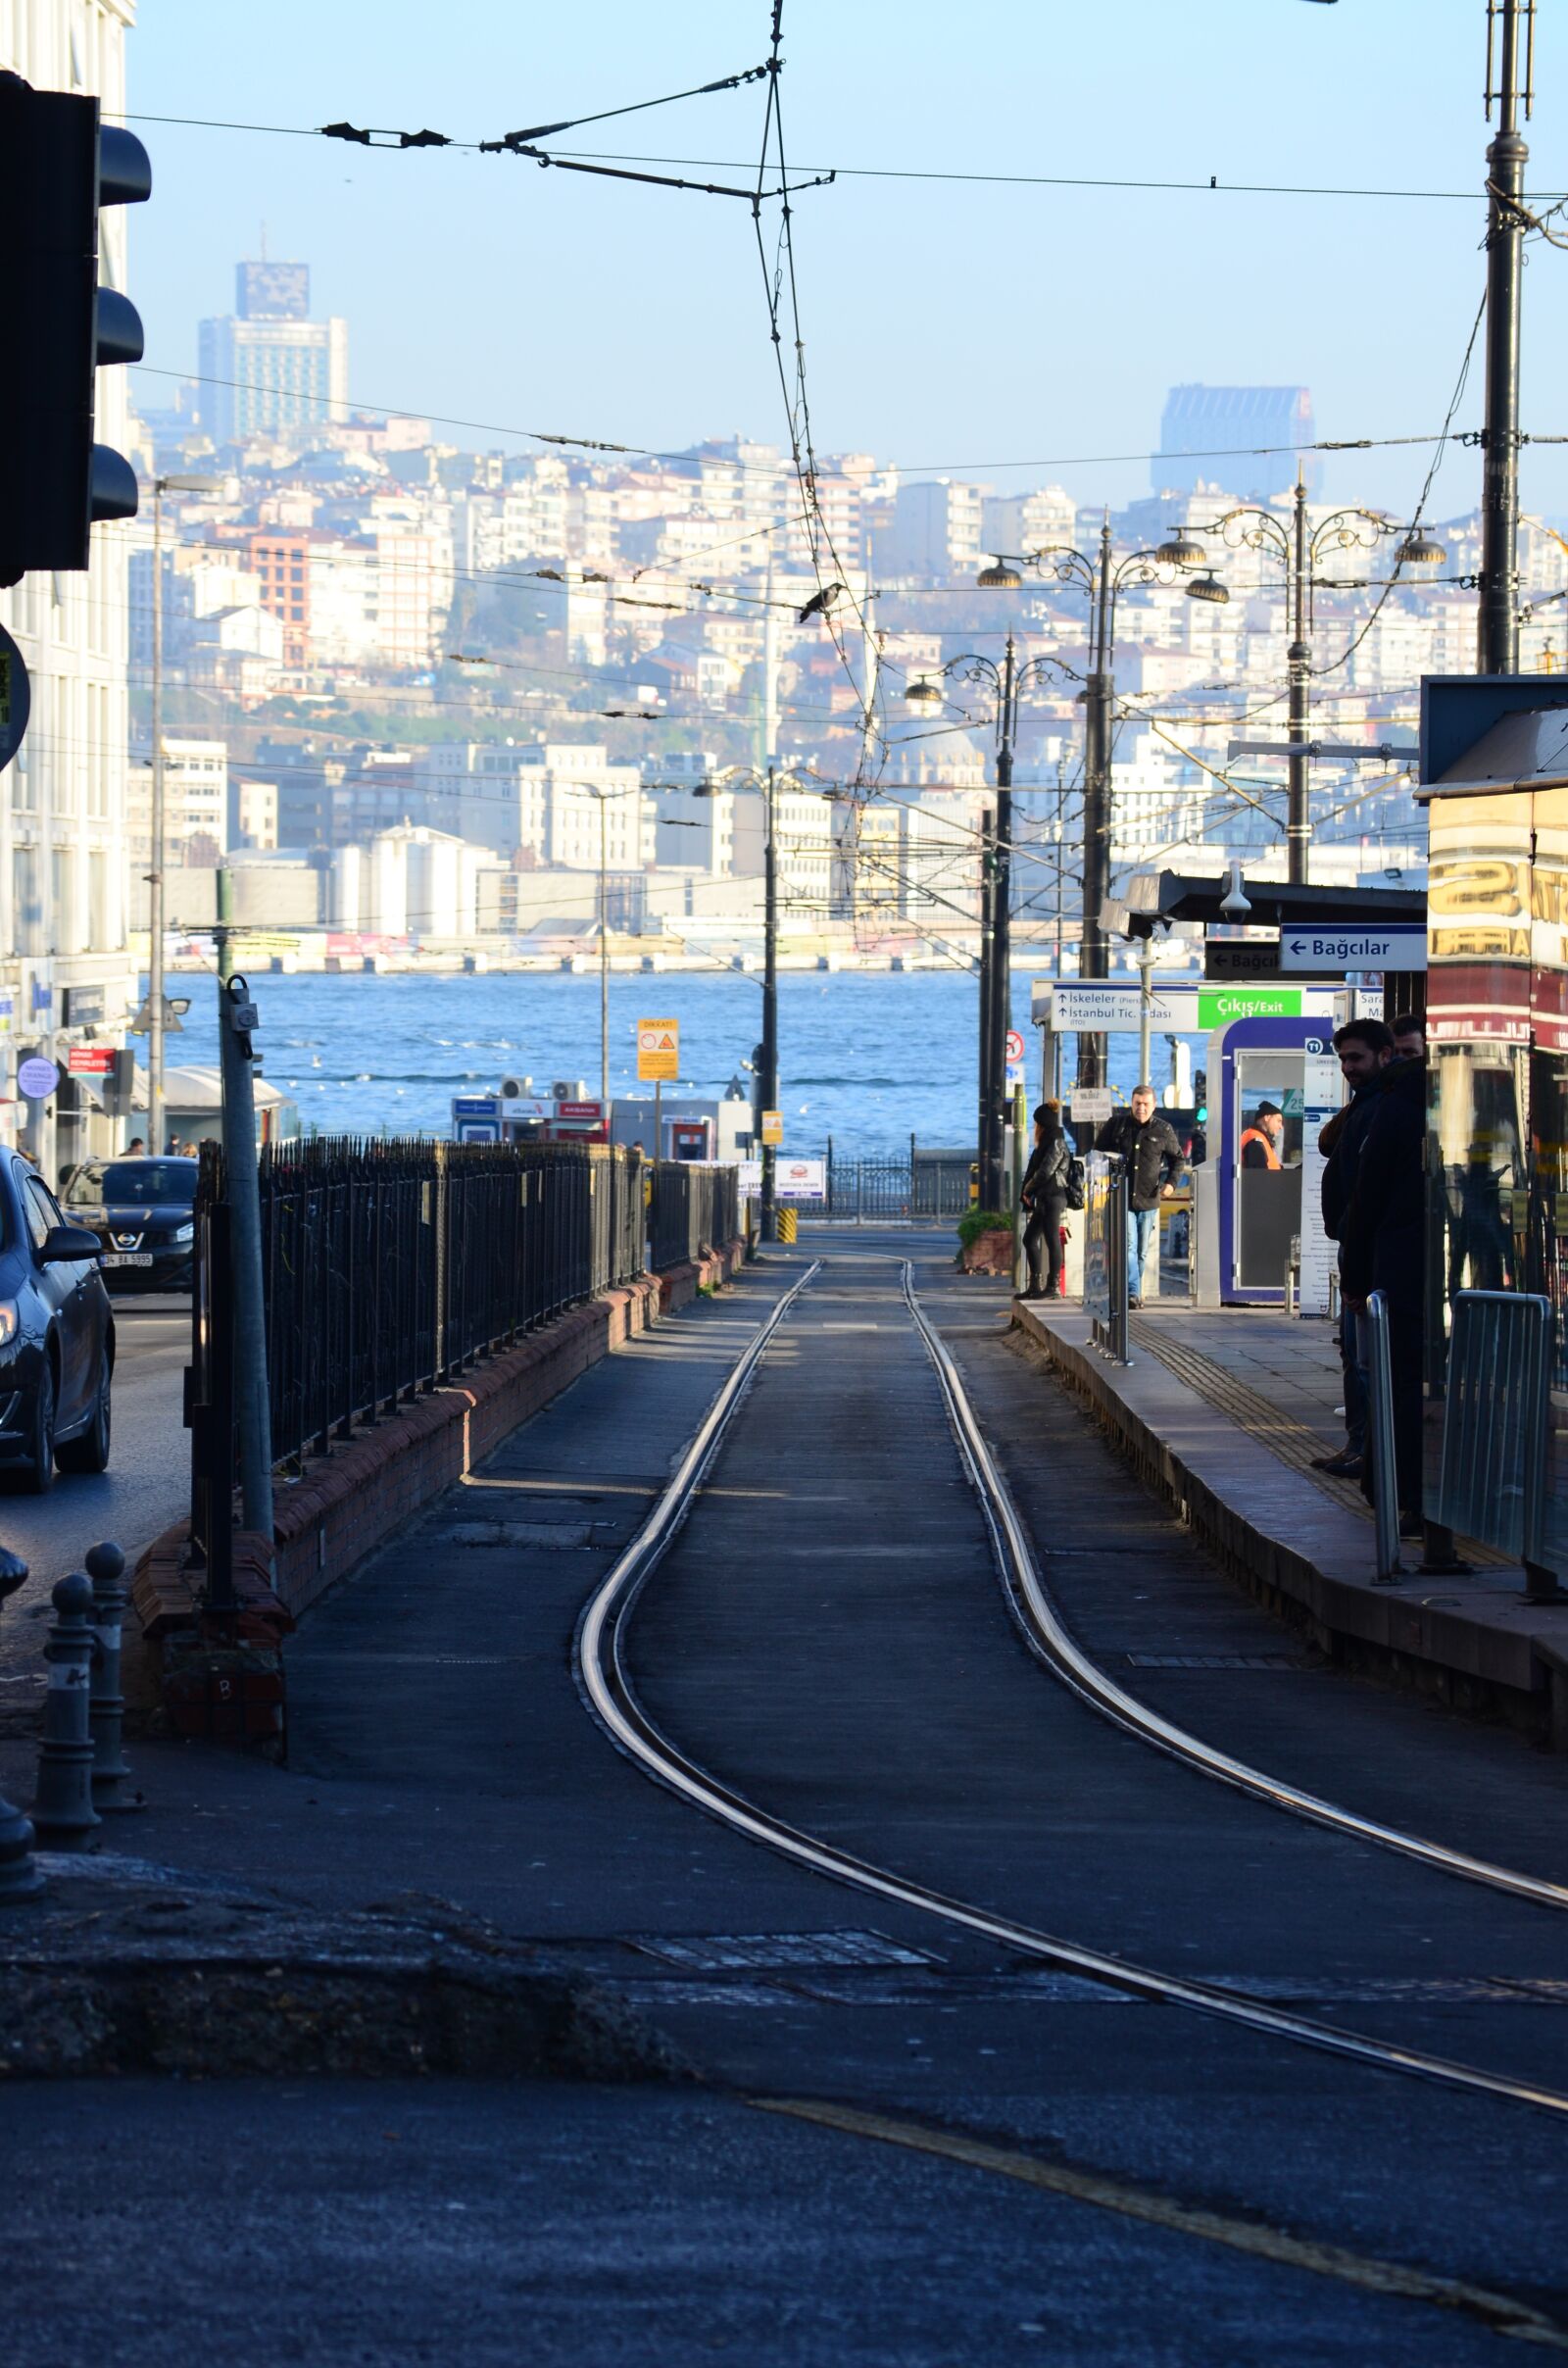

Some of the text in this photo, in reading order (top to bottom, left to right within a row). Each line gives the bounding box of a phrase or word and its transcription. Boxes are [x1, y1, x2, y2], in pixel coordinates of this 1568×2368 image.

[1313, 938, 1390, 960] Bağcılar
[1232, 953, 1279, 970] Bağcıl
[1069, 993, 1115, 1004] İskeleler
[1361, 994, 1384, 1004] Sara
[1069, 1007, 1171, 1018] İstanbul Tic. dası
[1216, 998, 1284, 1016] Çıkış/Exit
[1368, 1008, 1384, 1017] Ma
[1308, 1043, 1319, 1052] T1
